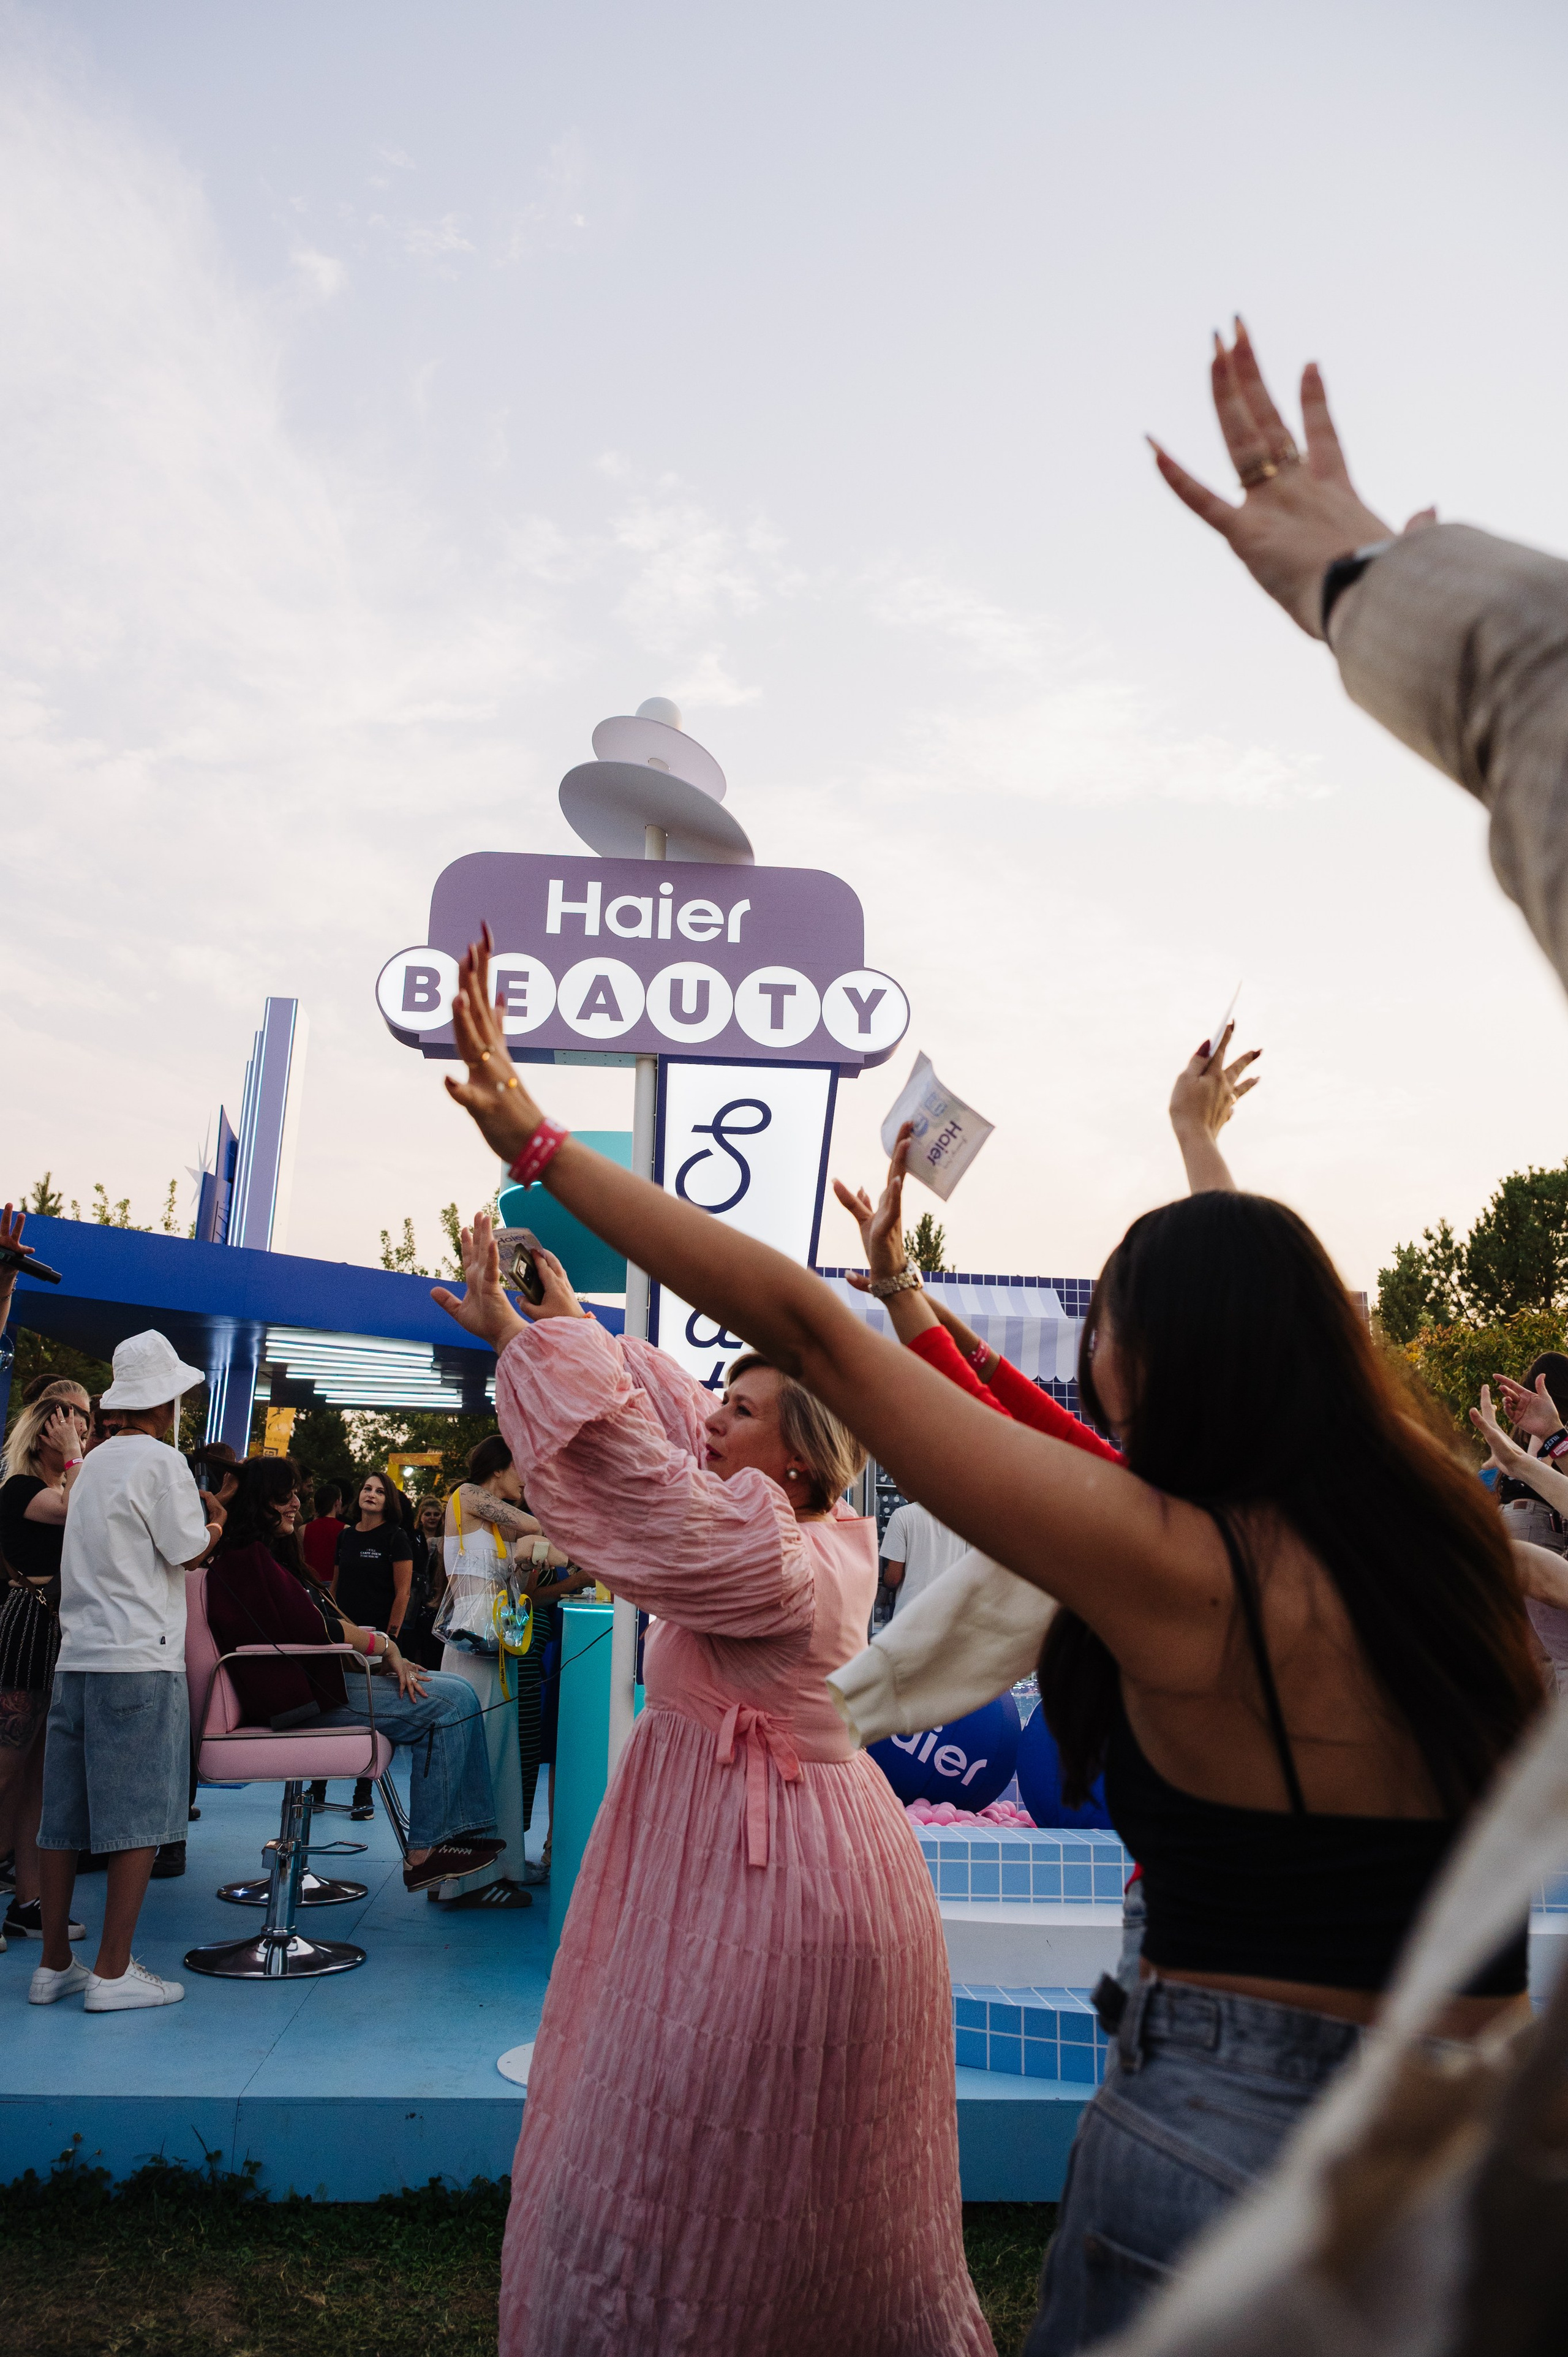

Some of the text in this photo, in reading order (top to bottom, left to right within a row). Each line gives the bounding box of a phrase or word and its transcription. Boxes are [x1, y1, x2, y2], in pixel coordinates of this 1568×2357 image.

[545, 879, 751, 943] Haier
[401, 965, 888, 1035] BEAUTY
[927, 1120, 962, 1166] Haier
[890, 1725, 988, 1786] aier
